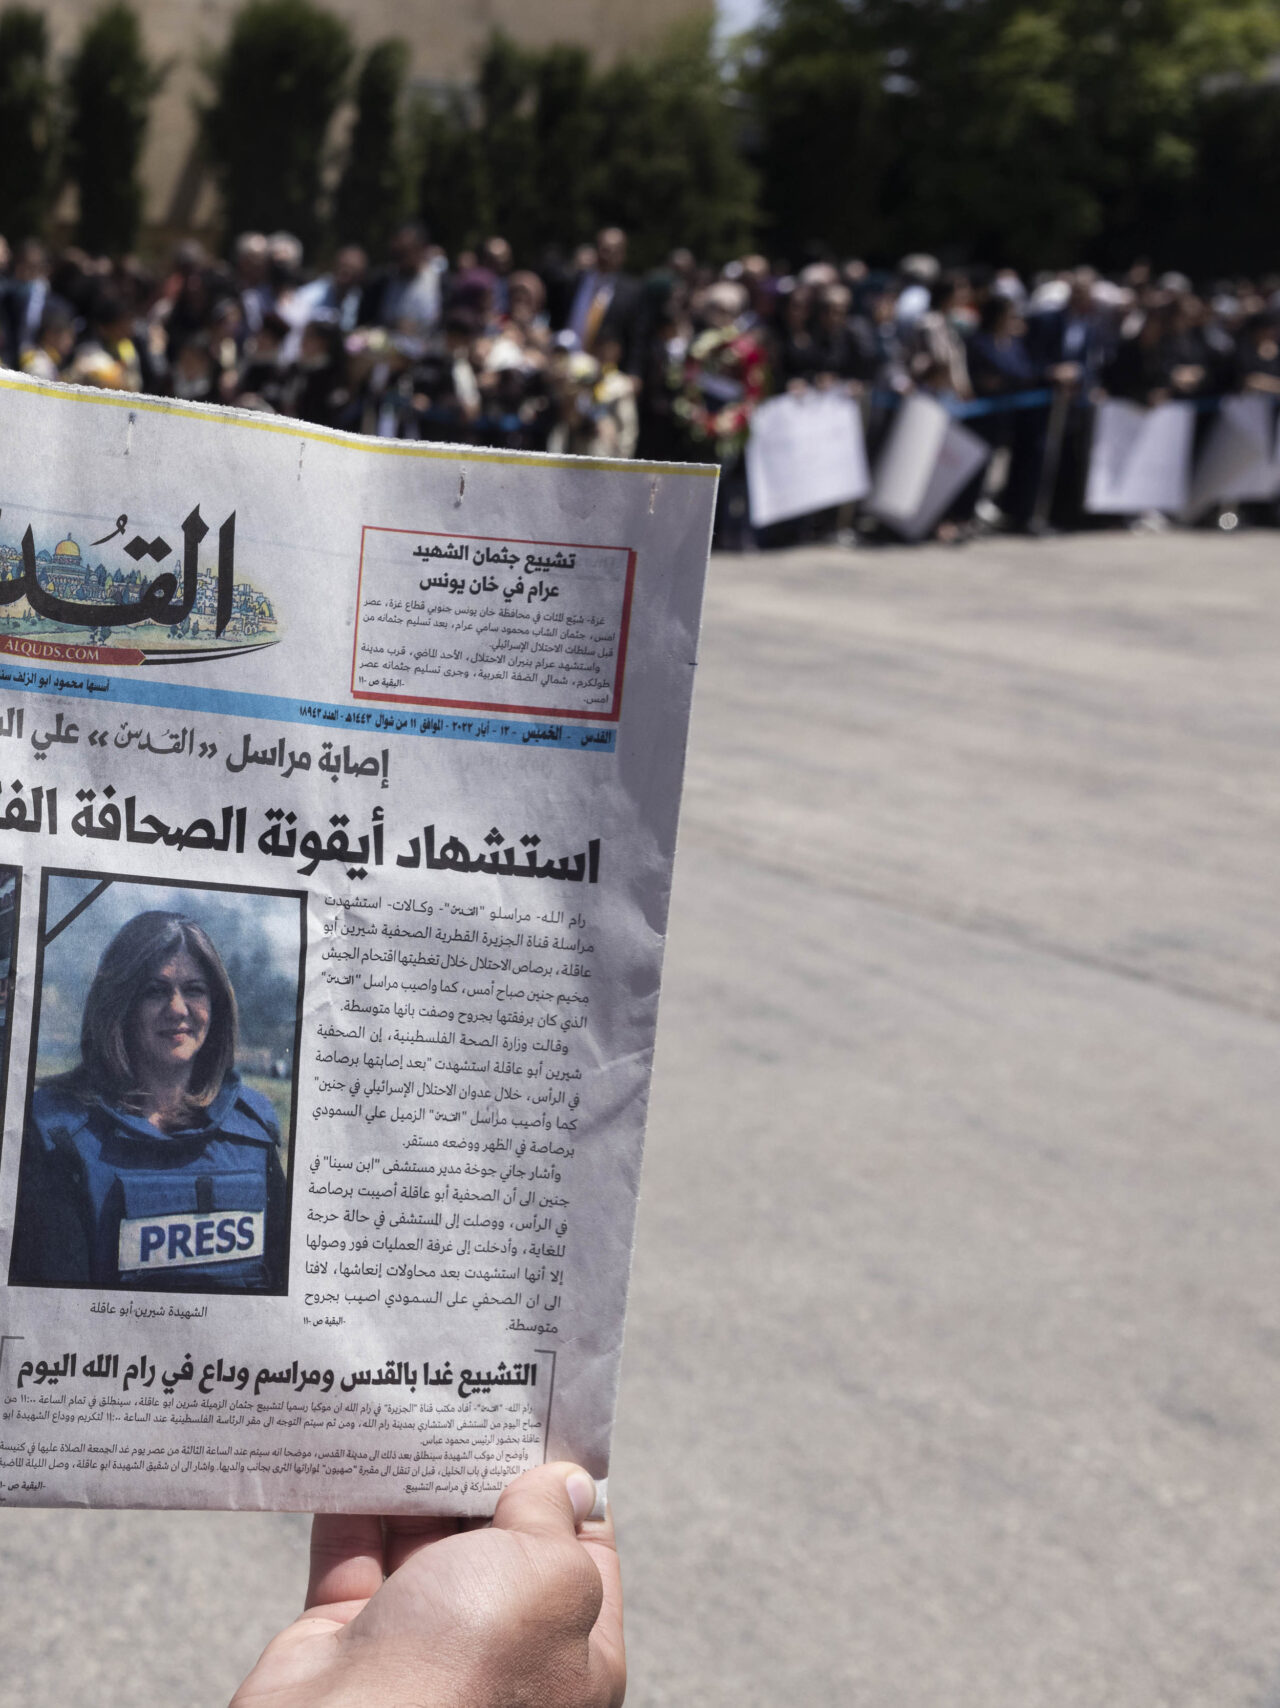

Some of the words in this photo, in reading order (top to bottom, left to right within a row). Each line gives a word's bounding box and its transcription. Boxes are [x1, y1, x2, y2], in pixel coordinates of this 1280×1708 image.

[413, 543, 469, 562] الشهيد
[473, 547, 520, 570] جثمان
[524, 552, 576, 574] تشييع
[419, 573, 465, 594] يونس
[469, 576, 499, 595] خان
[503, 576, 524, 603] في
[527, 581, 559, 603] عرام
[4, 638, 101, 663] ALQUDS.COM
[31, 712, 79, 759] علي
[226, 734, 311, 778] مراسل
[318, 742, 389, 788] إصابة
[72, 785, 247, 853] الصحافة
[258, 806, 384, 880] أيقونة
[396, 825, 600, 883] استشهاد
[324, 896, 381, 911] استشهدت
[490, 907, 530, 923] مراسلو
[569, 913, 586, 929] رام
[324, 920, 337, 934] أبو
[341, 920, 377, 937] شيرين
[381, 924, 432, 939] الصحفية
[435, 928, 479, 943] القطرية
[482, 932, 524, 948] الجزيرة
[526, 935, 549, 948] قناة
[552, 938, 595, 954] مراسلة
[322, 947, 360, 961] الجيش
[361, 948, 396, 965] اقتحام
[398, 950, 440, 967] تغطيتها
[441, 954, 468, 969] خلال
[469, 956, 511, 971] الاحتلال
[512, 960, 552, 977] برصاص
[556, 964, 592, 978] عاقلة،
[360, 974, 398, 992] مراسل
[401, 978, 437, 994] واصيب
[440, 979, 459, 993] كما
[462, 981, 495, 997] أمس،
[496, 984, 525, 1001] صباح
[527, 990, 555, 1002] جنين
[557, 992, 589, 1007] مخيم
[341, 1000, 390, 1016] متوسطة.
[394, 1002, 414, 1018] بانها
[419, 1009, 454, 1021] وصفت
[458, 1012, 493, 1024] بجروح
[497, 1009, 534, 1027] برفقتها
[537, 1014, 557, 1028] كان
[560, 1016, 587, 1033] الذي
[140, 1216, 254, 1262] PRESS
[90, 1302, 116, 1314] عاقلة
[120, 1301, 133, 1317] أبو
[134, 1306, 165, 1319] شيرين
[168, 1306, 207, 1320] الشهيدة
[17, 1353, 77, 1388] اليوم
[82, 1354, 119, 1378] الله
[123, 1355, 155, 1391] رام
[162, 1353, 194, 1394] في
[423, 1361, 453, 1385] غدا
[198, 1358, 249, 1394] وداع
[254, 1360, 334, 1395] ومراسم
[340, 1360, 417, 1393] بالقدس
[458, 1361, 537, 1397] التشييع
